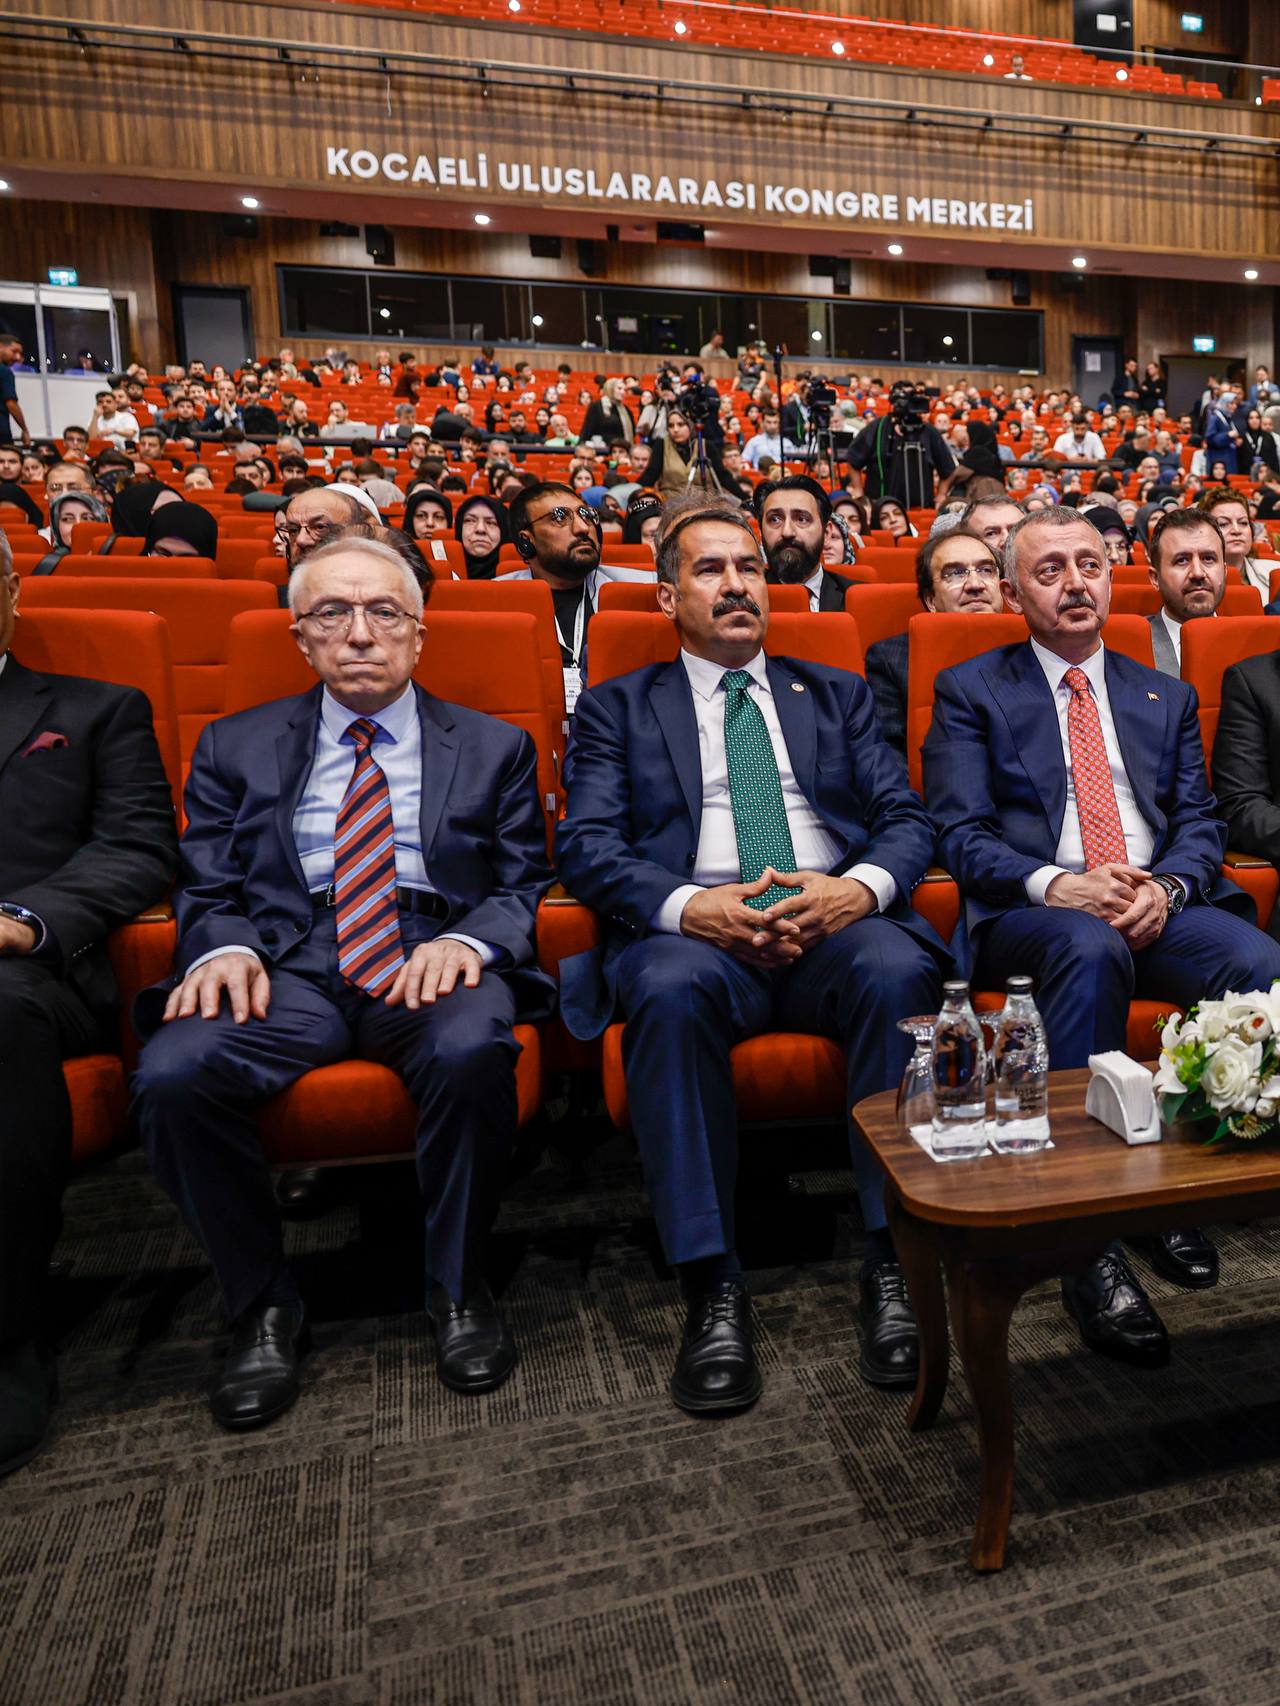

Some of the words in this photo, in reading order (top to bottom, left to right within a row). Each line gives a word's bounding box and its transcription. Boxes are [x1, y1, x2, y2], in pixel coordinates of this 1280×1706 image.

[326, 147, 489, 189] KOCAELİ
[497, 162, 756, 210] ULUSLARARASI
[764, 184, 899, 221] KONGRE
[905, 195, 1033, 231] MERKEZİ
